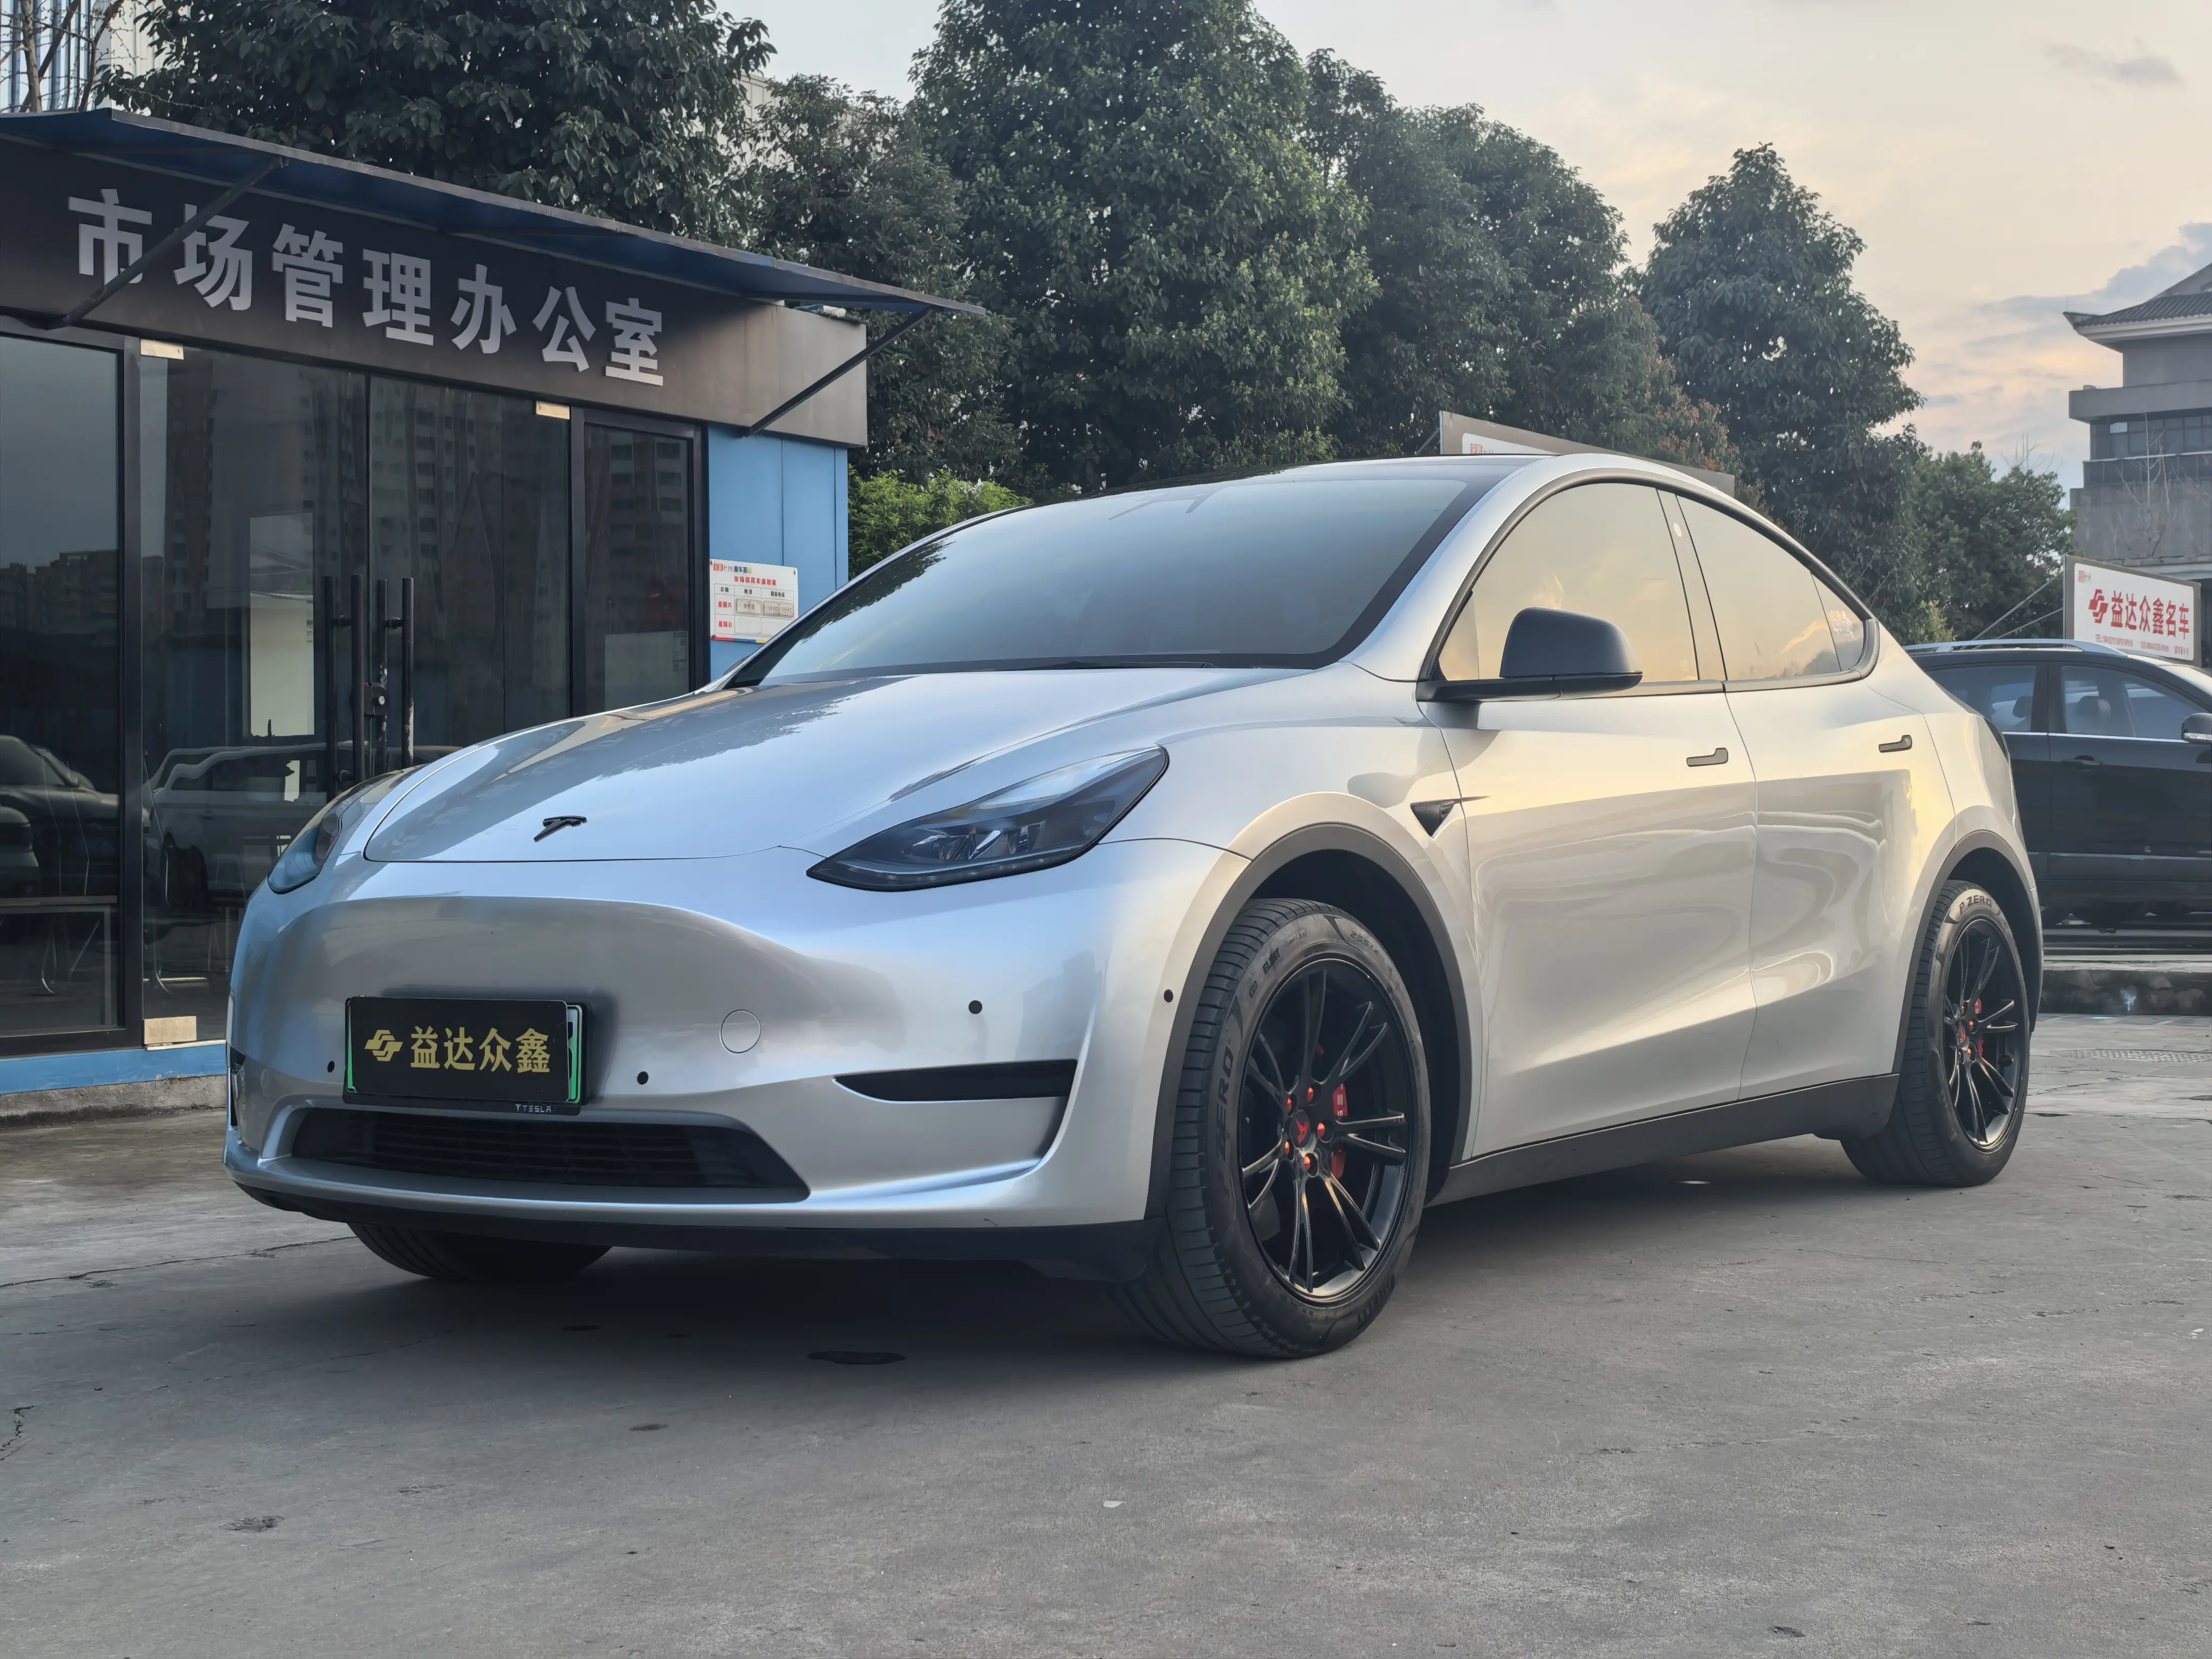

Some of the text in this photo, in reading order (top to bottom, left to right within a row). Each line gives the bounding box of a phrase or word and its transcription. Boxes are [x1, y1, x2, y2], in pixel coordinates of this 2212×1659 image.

[67, 188, 664, 386] 市场管理办公室
[2110, 590, 2190, 640] 益达众鑫名车
[1959, 894, 1992, 914] P ZERO
[410, 1026, 550, 1074] 益达众鑫
